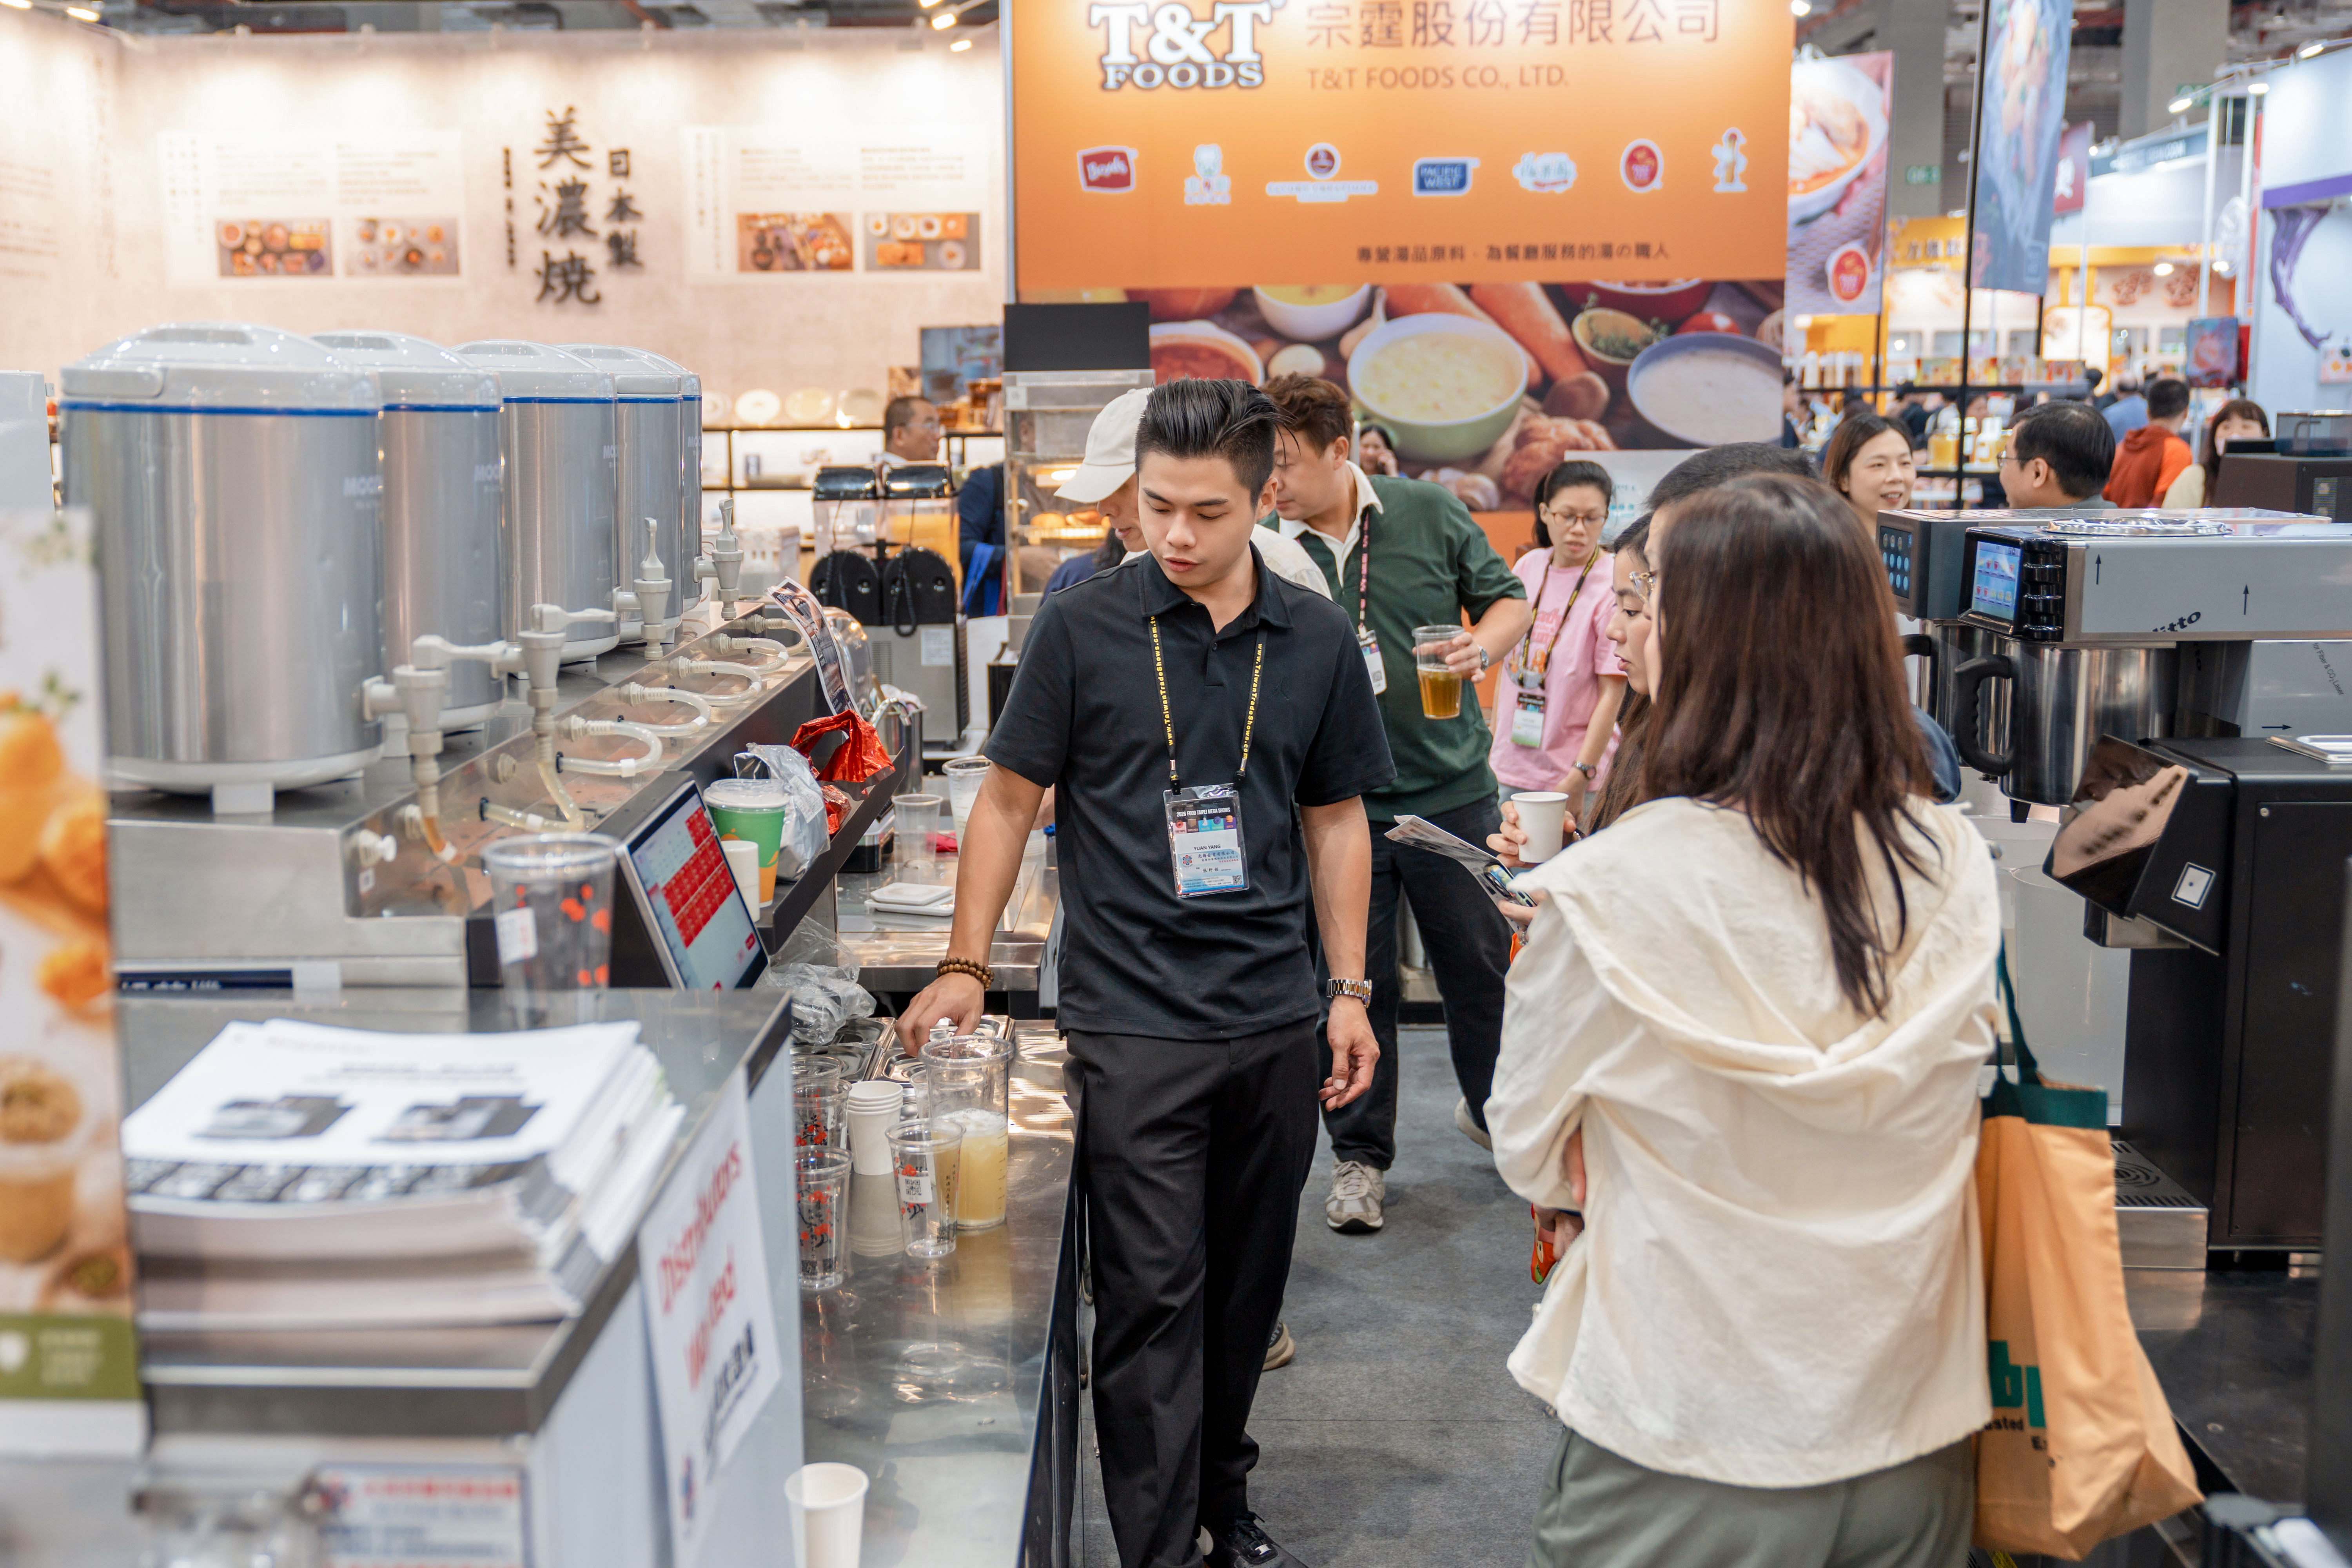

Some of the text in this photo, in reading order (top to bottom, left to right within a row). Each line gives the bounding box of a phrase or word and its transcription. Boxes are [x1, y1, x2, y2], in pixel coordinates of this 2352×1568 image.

[1091, 3, 1271, 64] T&T
[1307, 0, 1718, 48] 宗霆股份有限公司
[1103, 62, 1264, 89] FOODS
[1308, 64, 1570, 90] T&T FOODS CO., LTD.
[1420, 163, 1463, 177] PACIFIC
[1423, 176, 1461, 189] WEST
[2152, 612, 2201, 632] tto
[2317, 650, 2327, 664] Fiber
[2333, 680, 2344, 695] Laser
